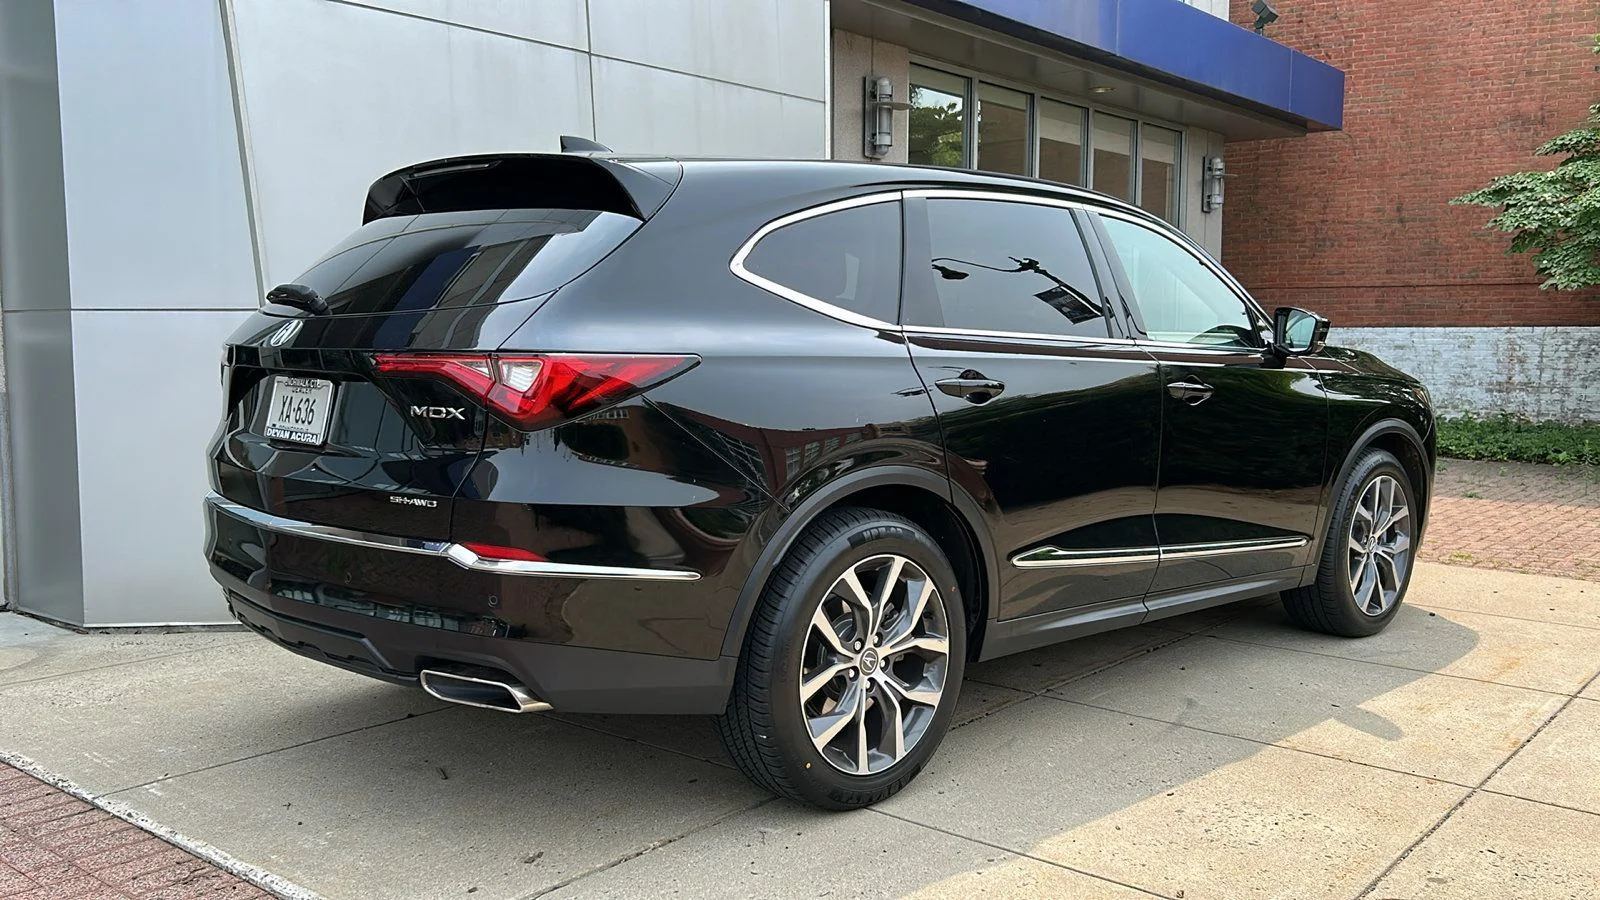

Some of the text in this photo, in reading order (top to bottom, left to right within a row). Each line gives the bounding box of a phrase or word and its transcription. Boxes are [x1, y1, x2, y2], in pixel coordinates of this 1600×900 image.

[410, 405, 466, 420] MDX
[267, 428, 316, 443] DEVAN ACURA
[390, 495, 438, 508] SH-AWD
